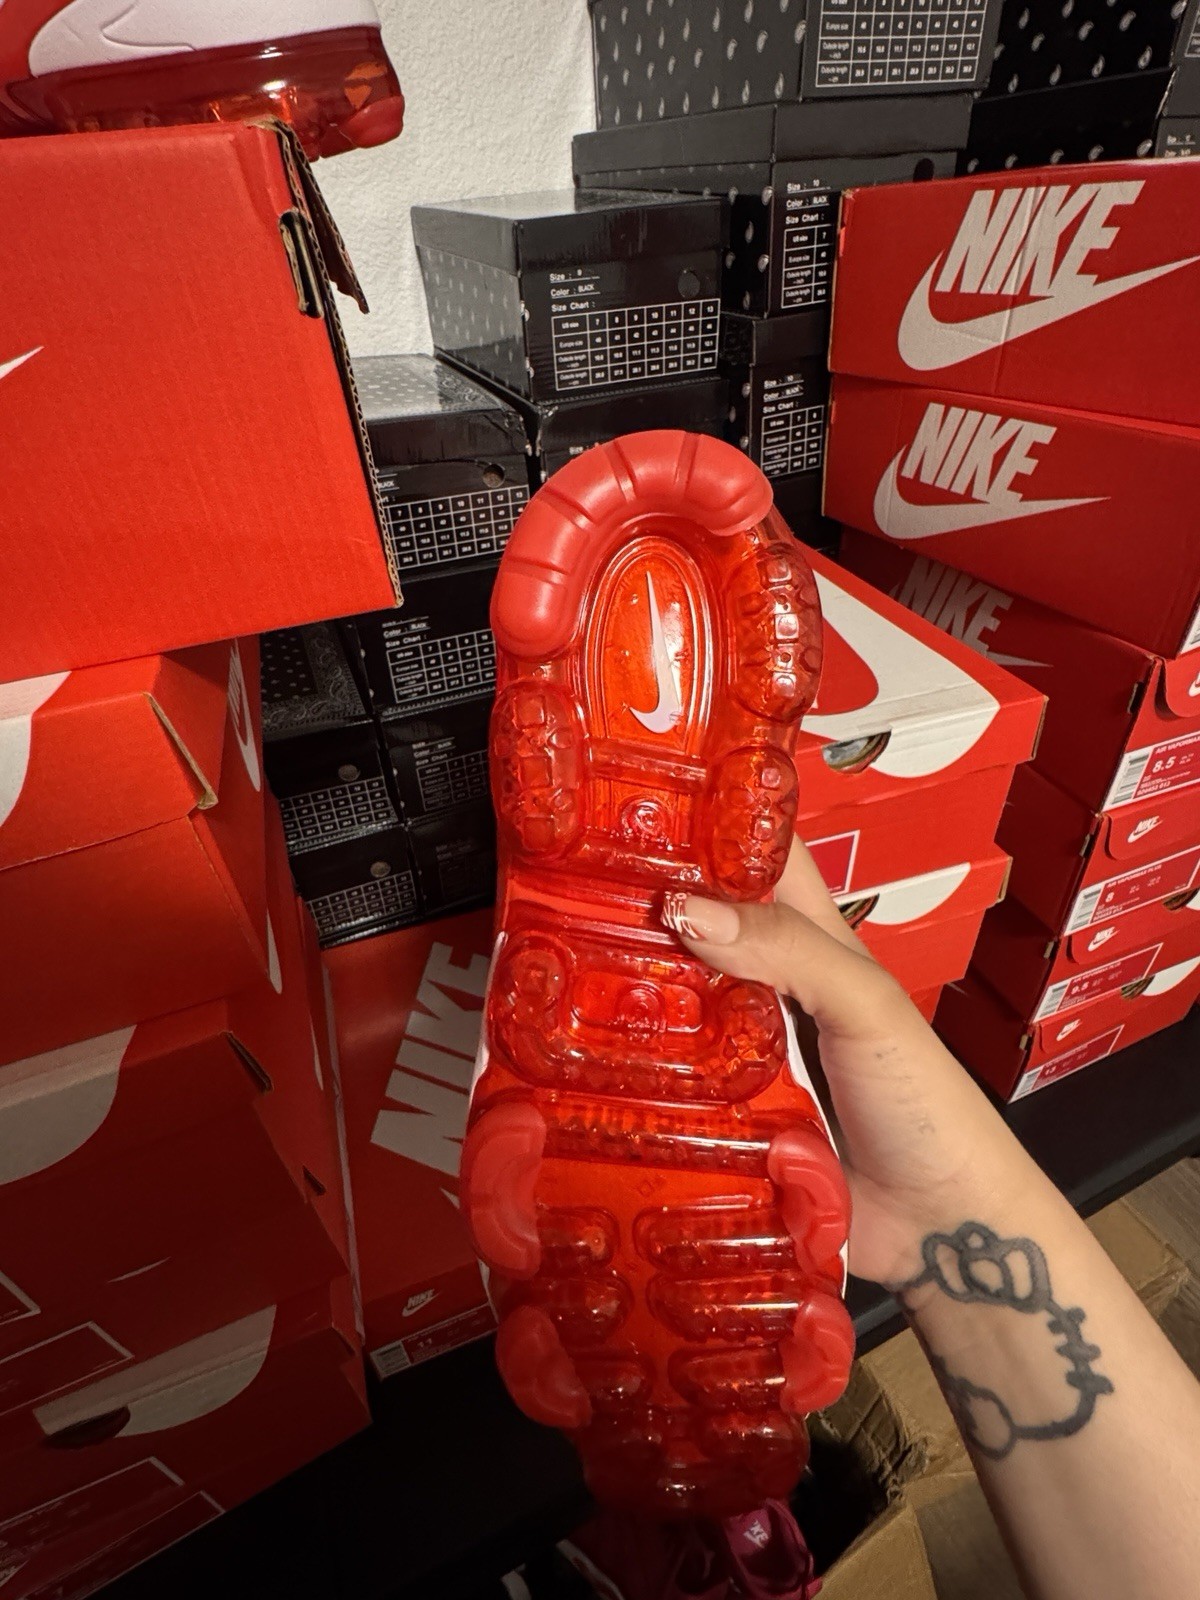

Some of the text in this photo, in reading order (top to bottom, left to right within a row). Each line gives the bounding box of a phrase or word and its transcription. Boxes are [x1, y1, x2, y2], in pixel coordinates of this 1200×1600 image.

[787, 183, 801, 192] Size
[786, 195, 827, 209] Color BLACK
[785, 213, 819, 225] Size Chart
[935, 180, 1145, 297] NIKE
[550, 284, 595, 297] Color BLACK
[551, 301, 589, 312] Size Chart
[901, 402, 1057, 503] NIKE
[898, 554, 1014, 659] NIKE
[1152, 756, 1177, 773] 8.5
[1134, 815, 1160, 832] NIKE
[1105, 892, 1115, 903] 8
[1071, 981, 1090, 995] 9.5
[370, 941, 490, 1178] NIKE
[407, 1288, 435, 1308] NIKE
